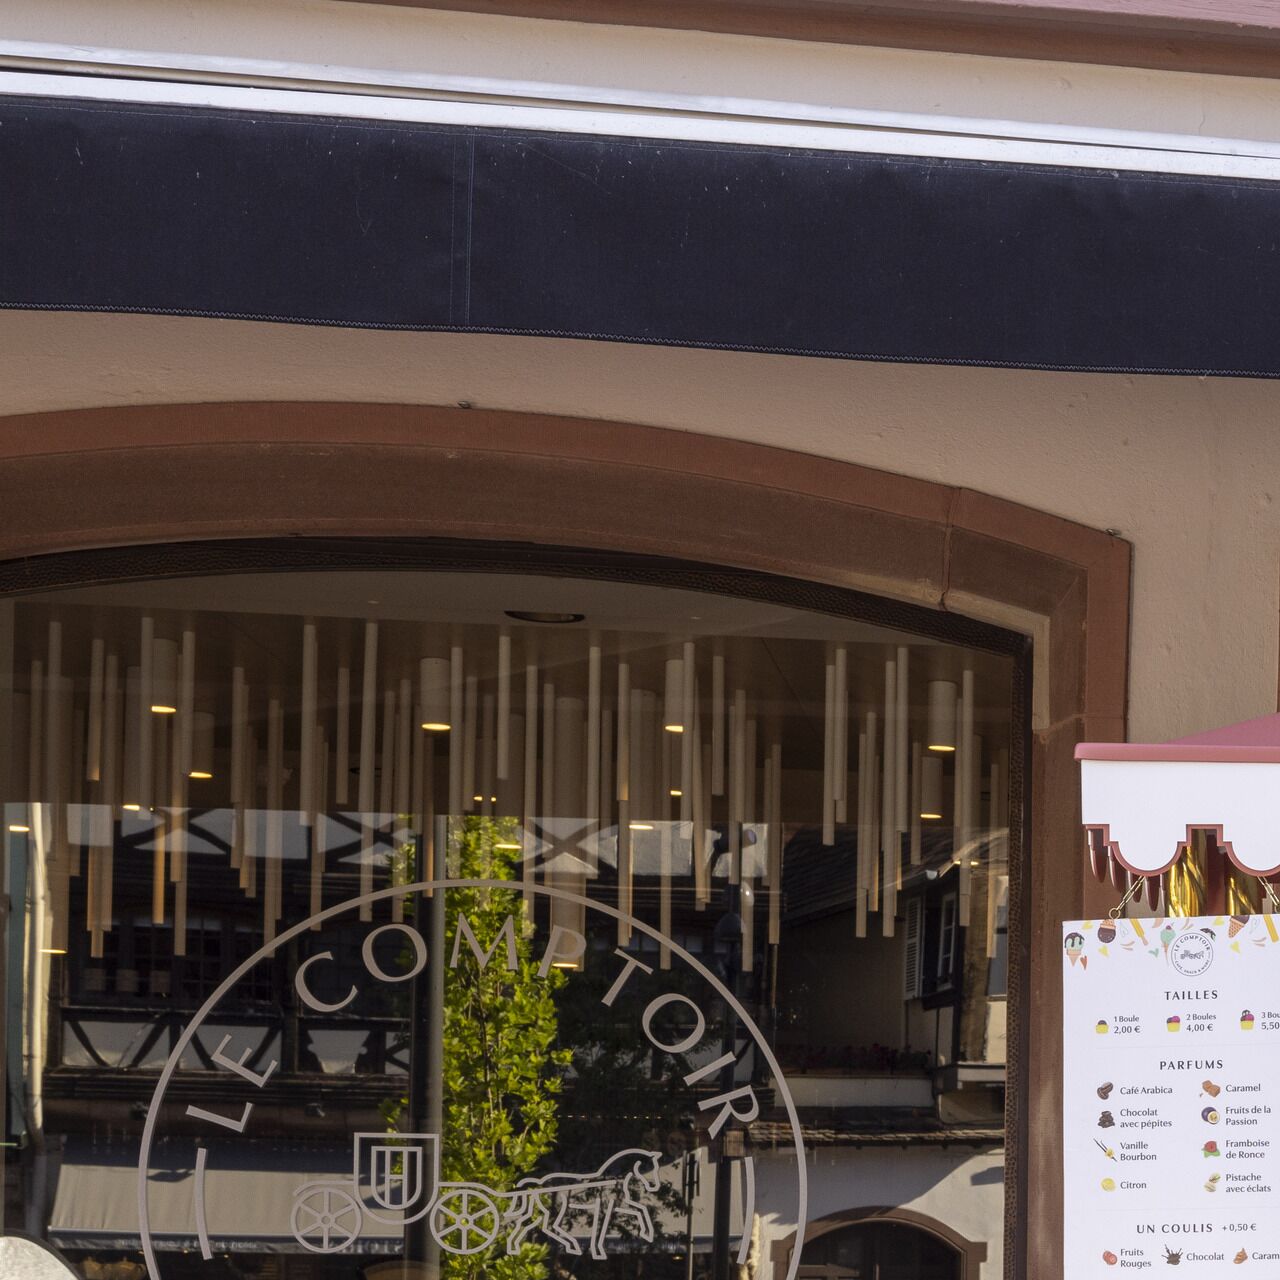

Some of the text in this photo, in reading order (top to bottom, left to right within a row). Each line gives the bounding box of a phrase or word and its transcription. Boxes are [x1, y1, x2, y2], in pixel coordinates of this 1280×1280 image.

[1164, 990, 1217, 1000] TAILLES
[185, 912, 760, 1139] LE COMPTOIR
[1114, 1025, 1140, 1034] 2,00 €
[1186, 1023, 1213, 1032] 4,00 €
[1262, 1022, 1280, 1030] 5,50
[1160, 1060, 1223, 1070] PARFUMS
[1120, 1086, 1172, 1095] Café Arabica
[1226, 1083, 1260, 1092] Caramel
[1120, 1108, 1158, 1116] Chocolat
[1226, 1106, 1248, 1114] Fruits
[1264, 1105, 1271, 1113] la
[1141, 1120, 1172, 1129] pépites
[1120, 1141, 1148, 1150] Vanille
[1226, 1139, 1270, 1147] Framboise
[1120, 1152, 1156, 1161] Bourbon
[1226, 1151, 1236, 1159] de
[1226, 1173, 1261, 1181] Pistache
[1120, 1181, 1146, 1189] Citron
[1247, 1184, 1271, 1192] éclats
[1137, 1225, 1155, 1233] UN
[1162, 1224, 1212, 1233] COULIS
[1250, 1223, 1256, 1231] €
[1121, 1248, 1144, 1256] Fruits
[1186, 1252, 1224, 1261] Chocolat
[1121, 1260, 1151, 1269] Rouges
